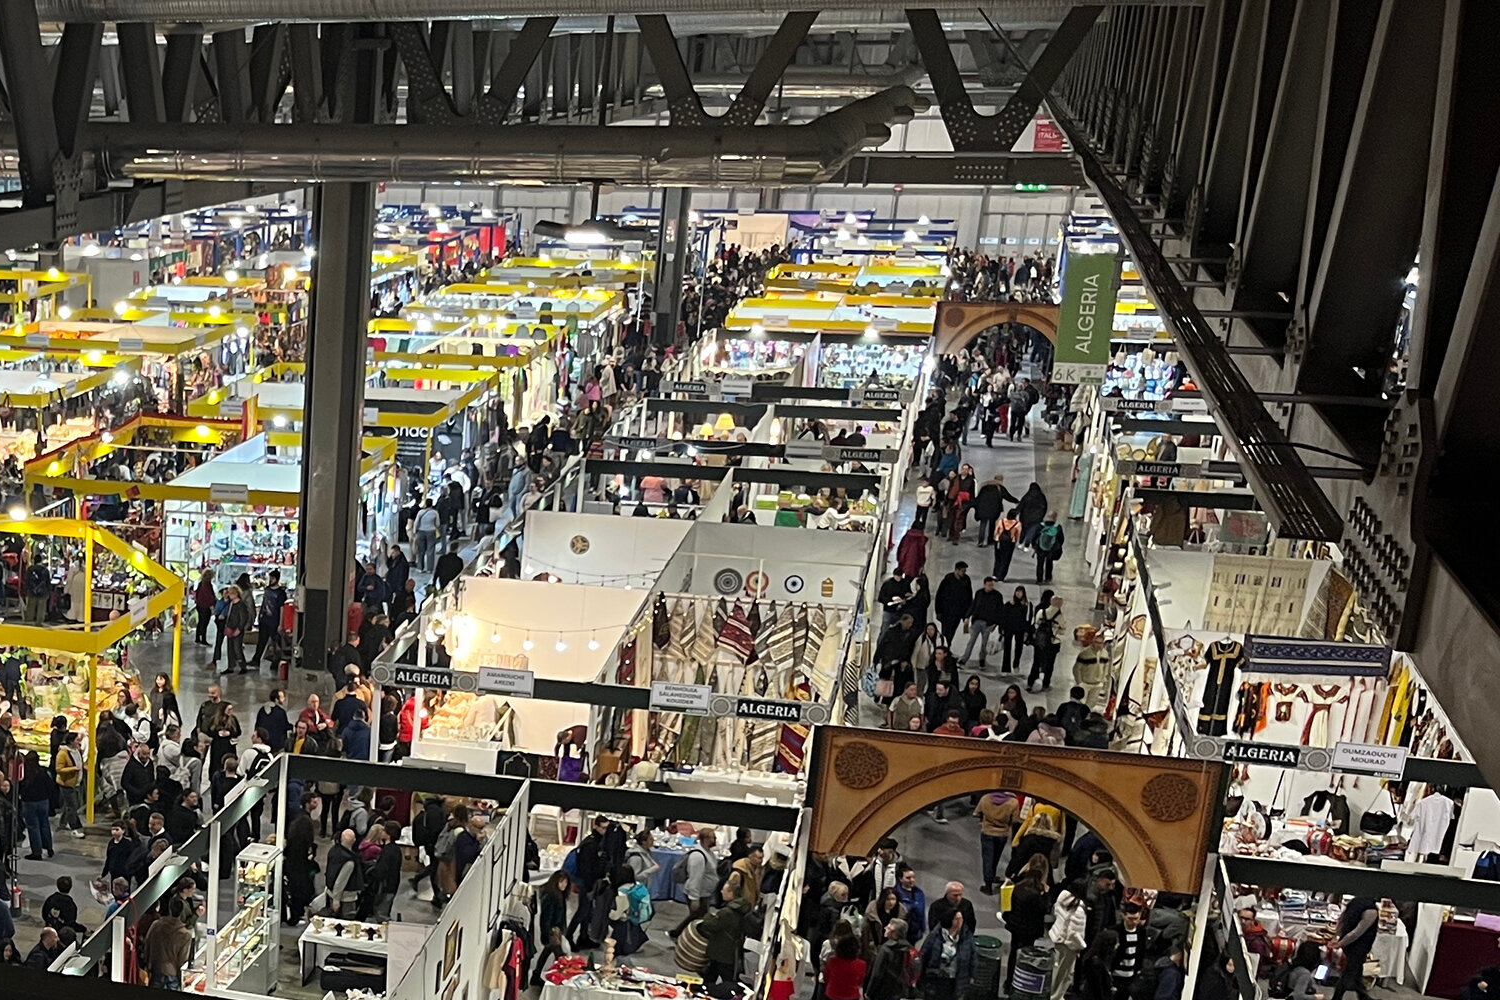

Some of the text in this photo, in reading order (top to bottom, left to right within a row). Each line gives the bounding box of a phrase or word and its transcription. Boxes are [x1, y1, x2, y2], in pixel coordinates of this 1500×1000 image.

[1075, 273, 1100, 354] ALGERIA
[674, 383, 705, 394] ALGERIA
[865, 391, 898, 401] ALGERIA
[1118, 401, 1154, 411] ALGERIA
[840, 450, 879, 461] ALGERIA
[1137, 464, 1180, 475] ALGERIA
[396, 669, 452, 686] ALGERIA
[738, 702, 799, 718] ALGERIA
[1225, 742, 1297, 765] ALGERIA
[1342, 747, 1398, 759] OUMZAOUCHE
[1350, 756, 1386, 766] MOURAD
